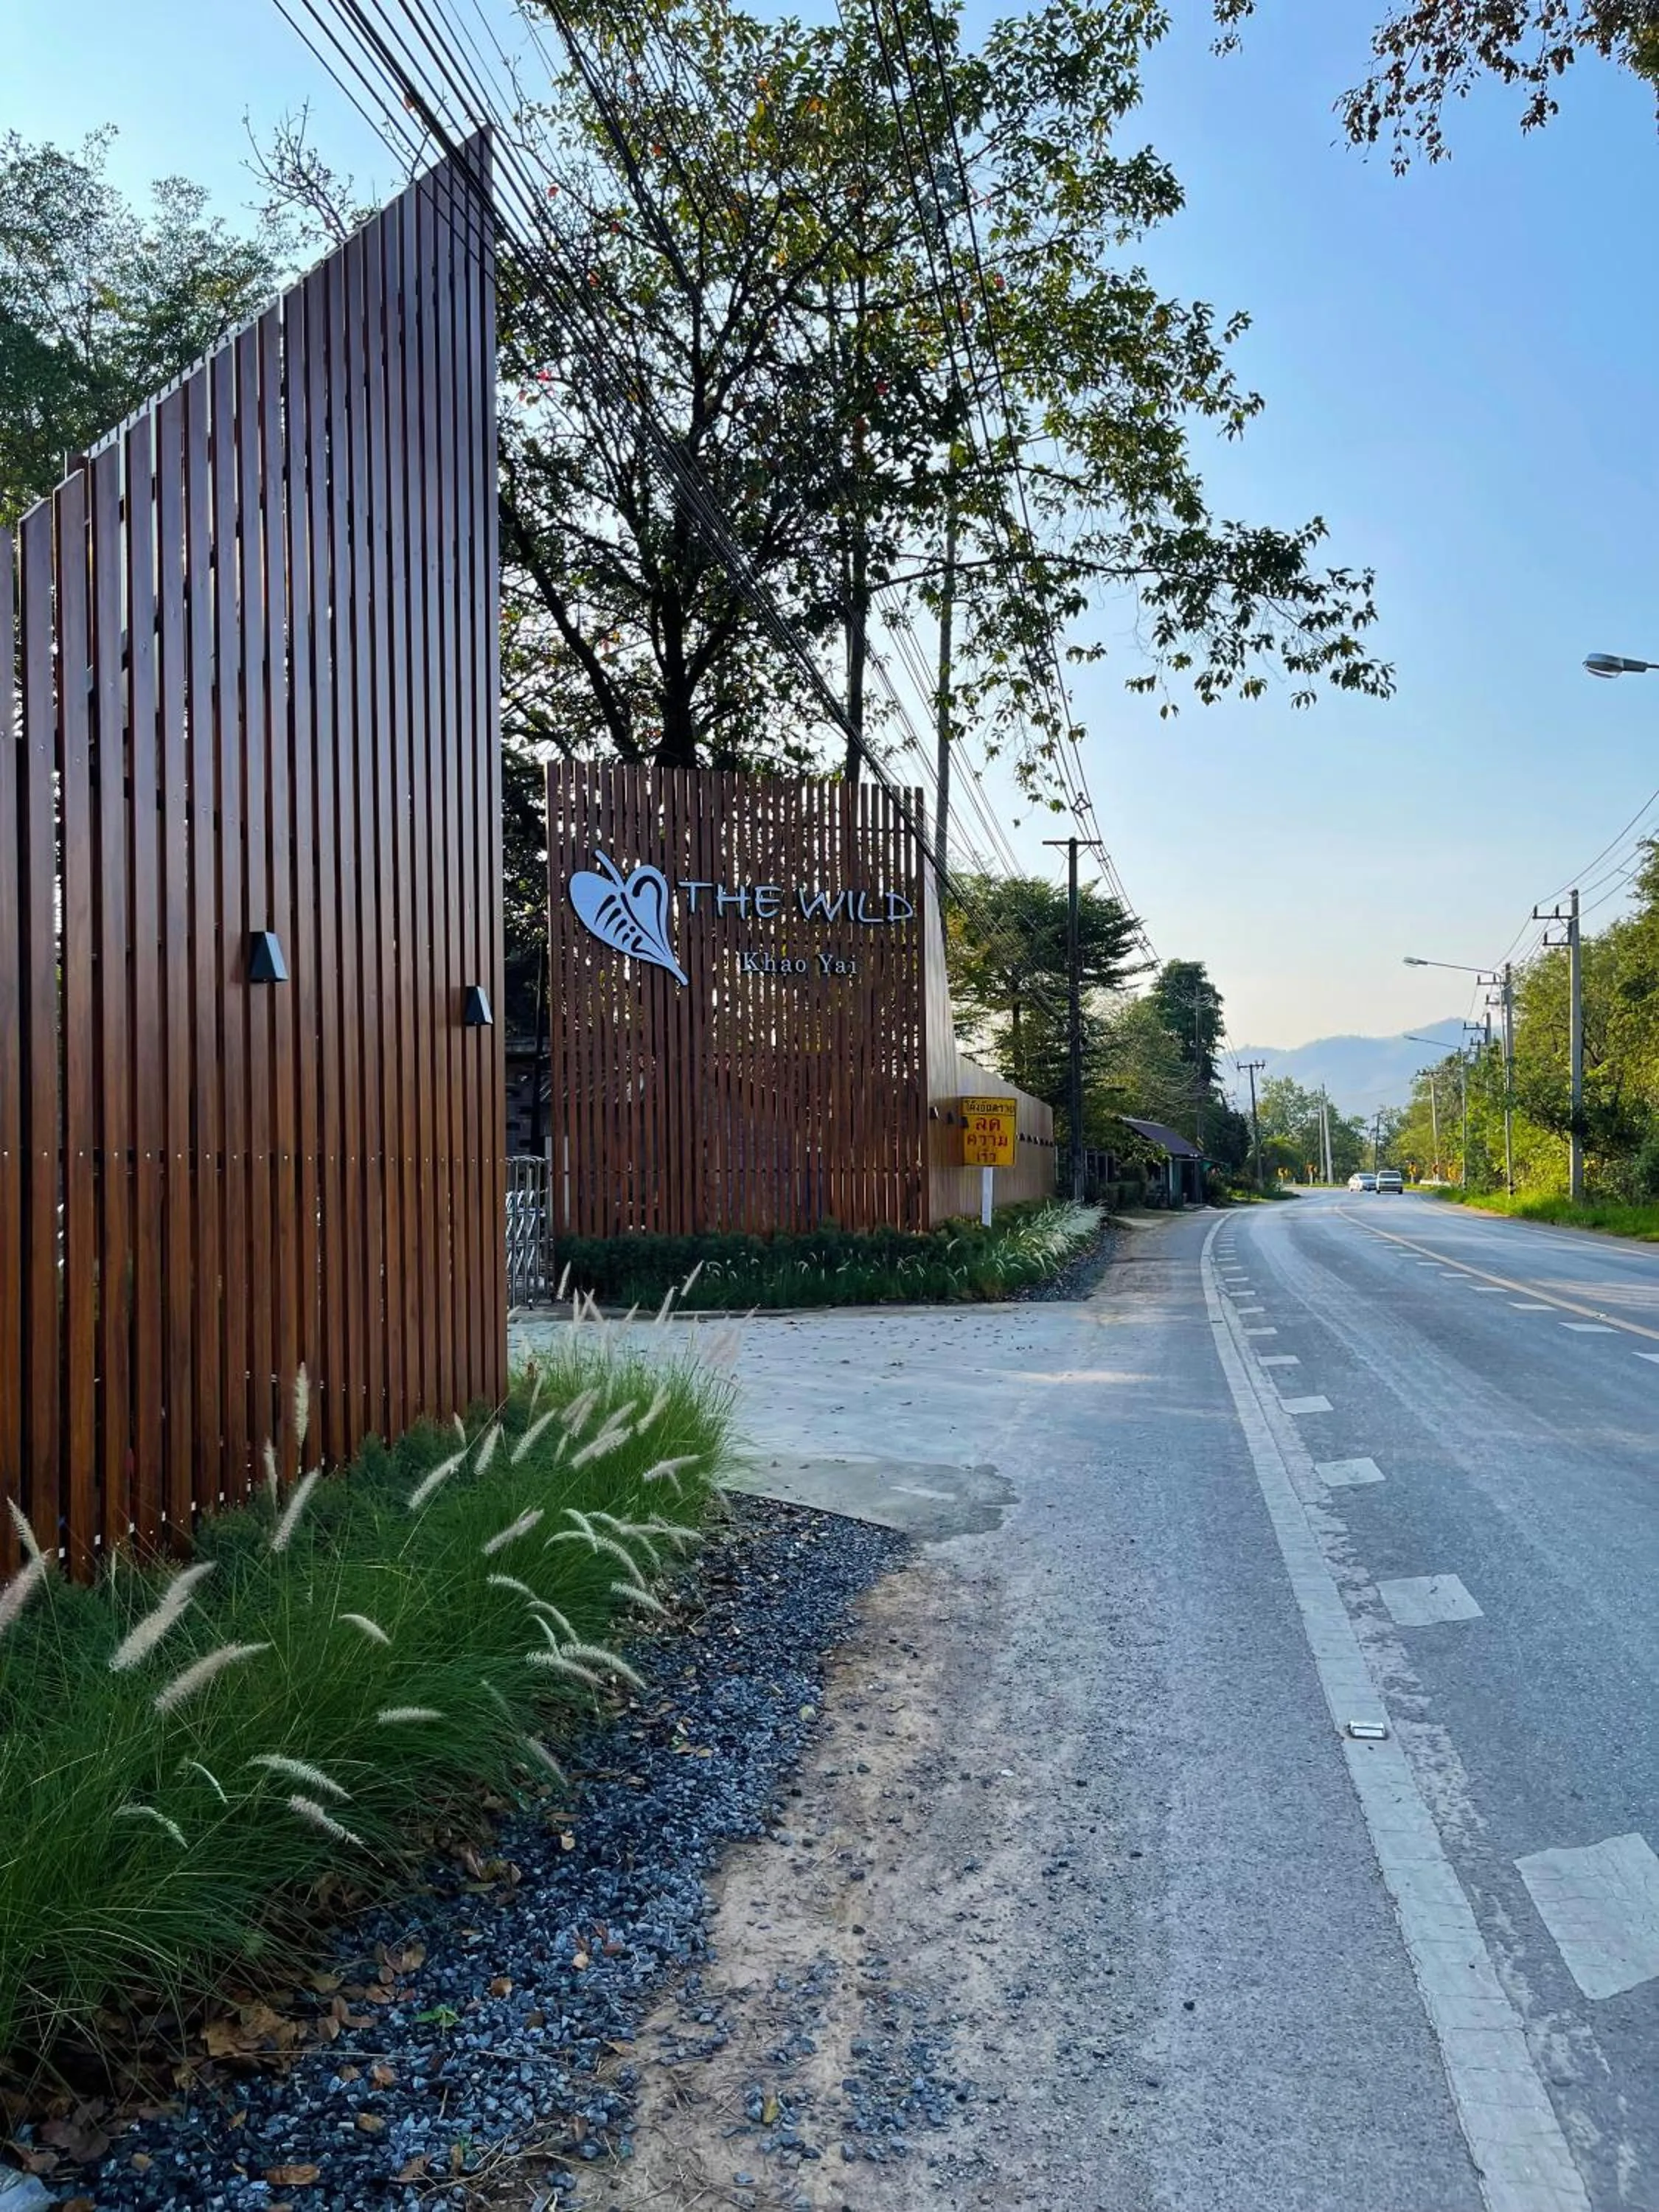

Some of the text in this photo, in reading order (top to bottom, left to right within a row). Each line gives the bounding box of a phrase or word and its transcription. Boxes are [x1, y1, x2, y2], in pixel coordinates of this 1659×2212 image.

[678, 881, 914, 922] THE WILD
[741, 952, 858, 974] Khao Yai
[975, 1117, 1001, 1131] ลด
[967, 1133, 1008, 1147] ความ
